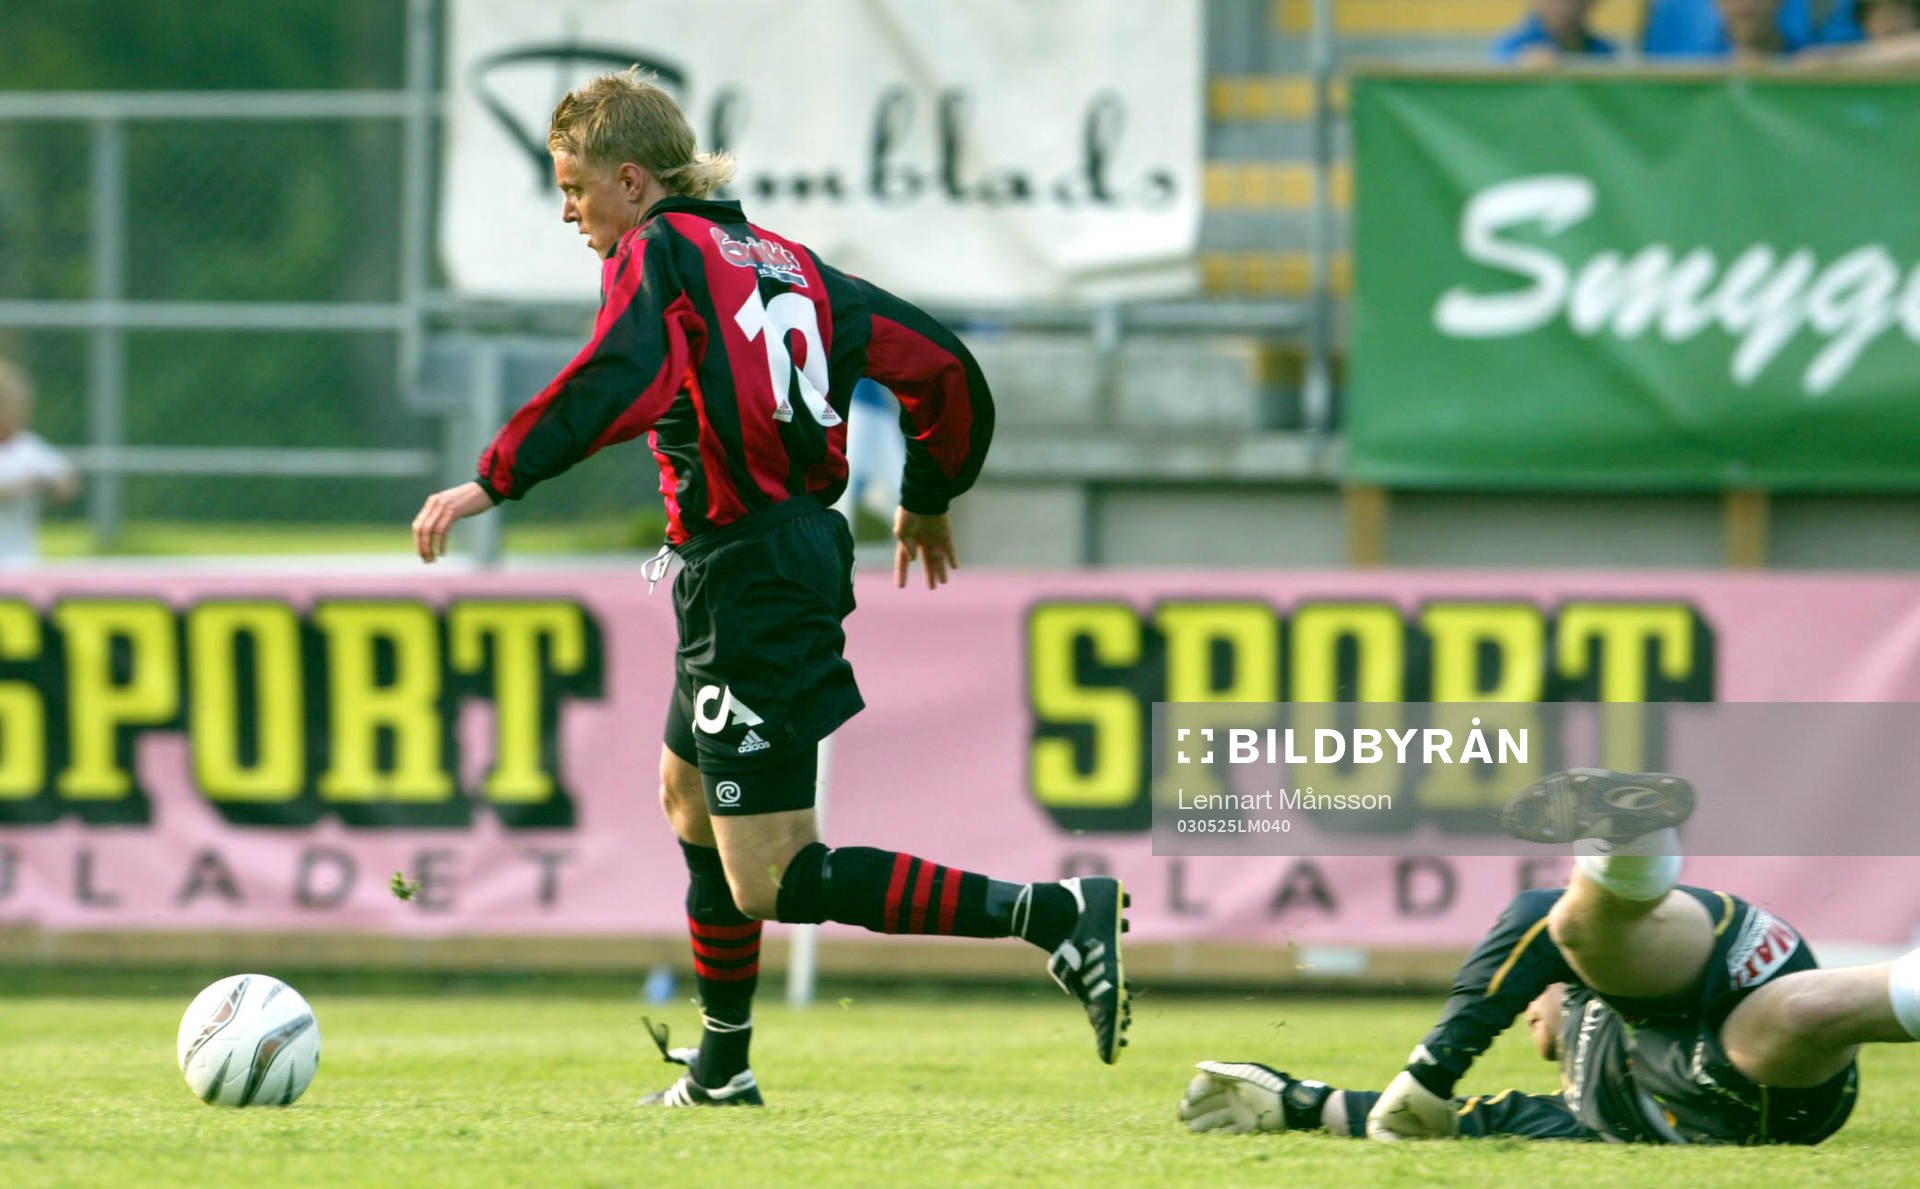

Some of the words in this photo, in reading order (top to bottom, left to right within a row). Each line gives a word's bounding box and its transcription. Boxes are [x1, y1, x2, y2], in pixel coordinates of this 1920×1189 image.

[470, 30, 1181, 203] Plmblads
[1028, 598, 1698, 808] SPORT
[0, 846, 580, 913] LADET
